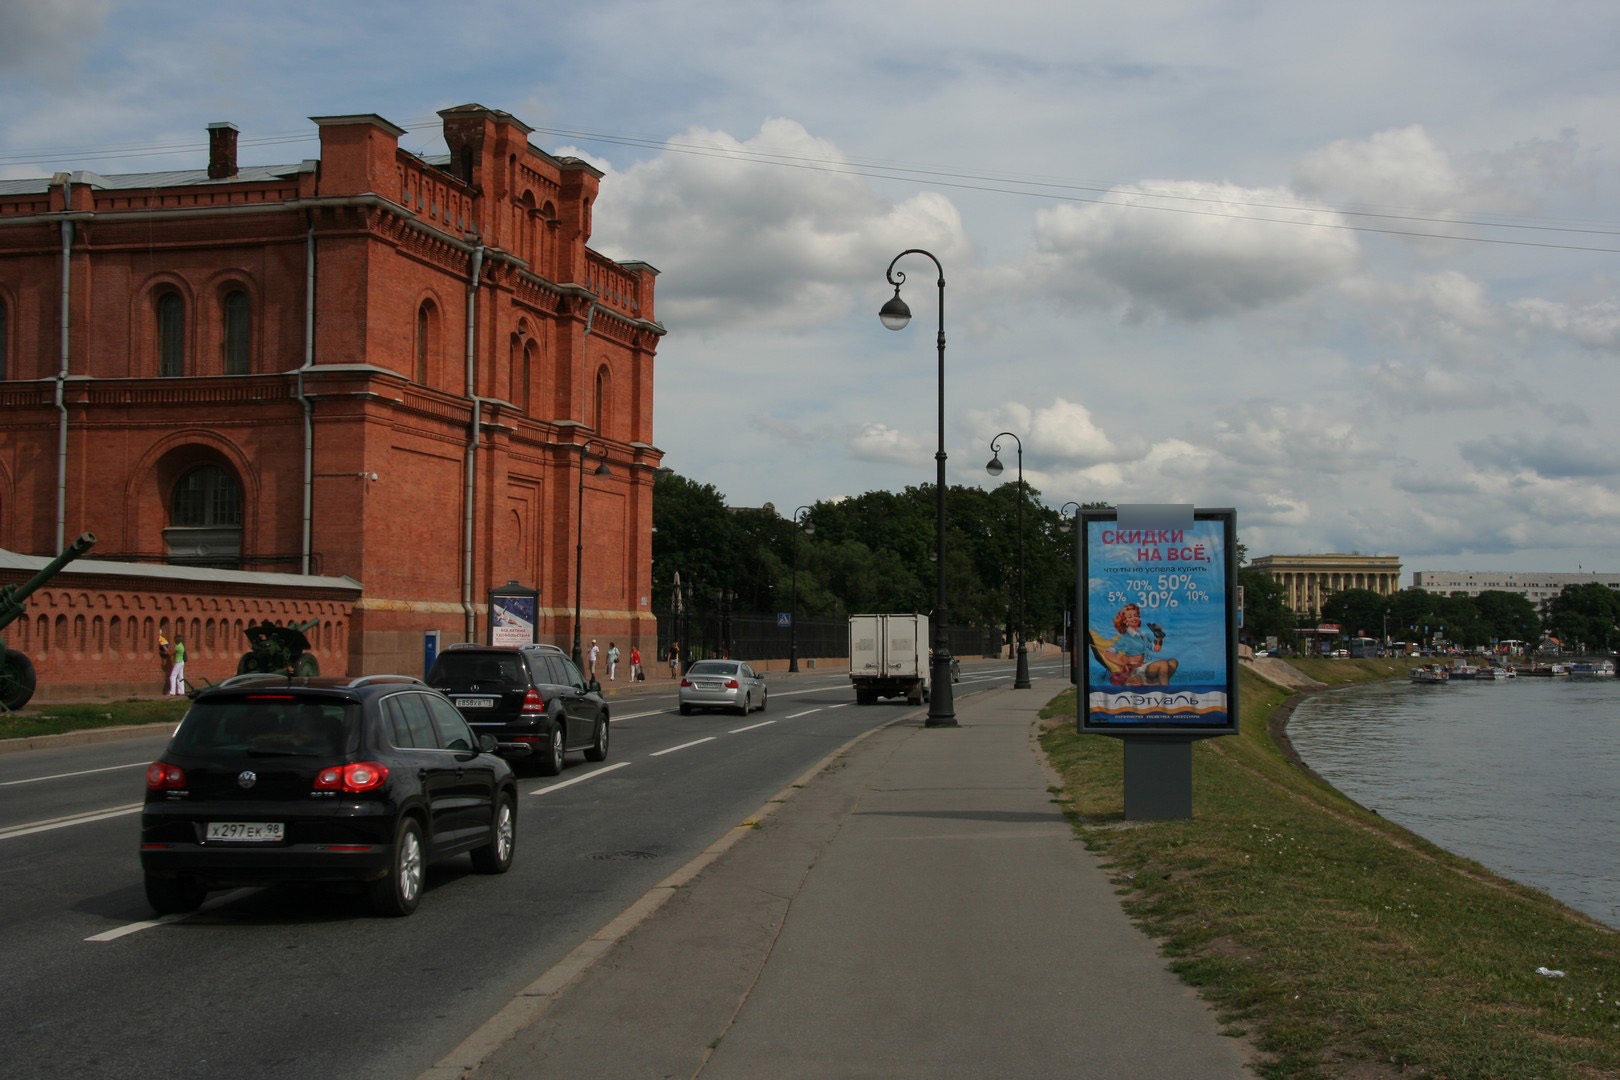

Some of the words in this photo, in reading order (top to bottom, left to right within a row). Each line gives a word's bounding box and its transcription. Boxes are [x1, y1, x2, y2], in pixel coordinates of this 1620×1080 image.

[1101, 530, 1184, 546] СКИДКИ
[1137, 548, 1162, 561] НА
[1167, 544, 1211, 563] ВСЁ,
[1178, 566, 1207, 574] купить
[1126, 580, 1153, 591] 70%
[1157, 574, 1197, 590] 50%
[1108, 592, 1127, 602] 5%
[1137, 591, 1179, 608] 30%
[1185, 591, 1209, 601] 10%
